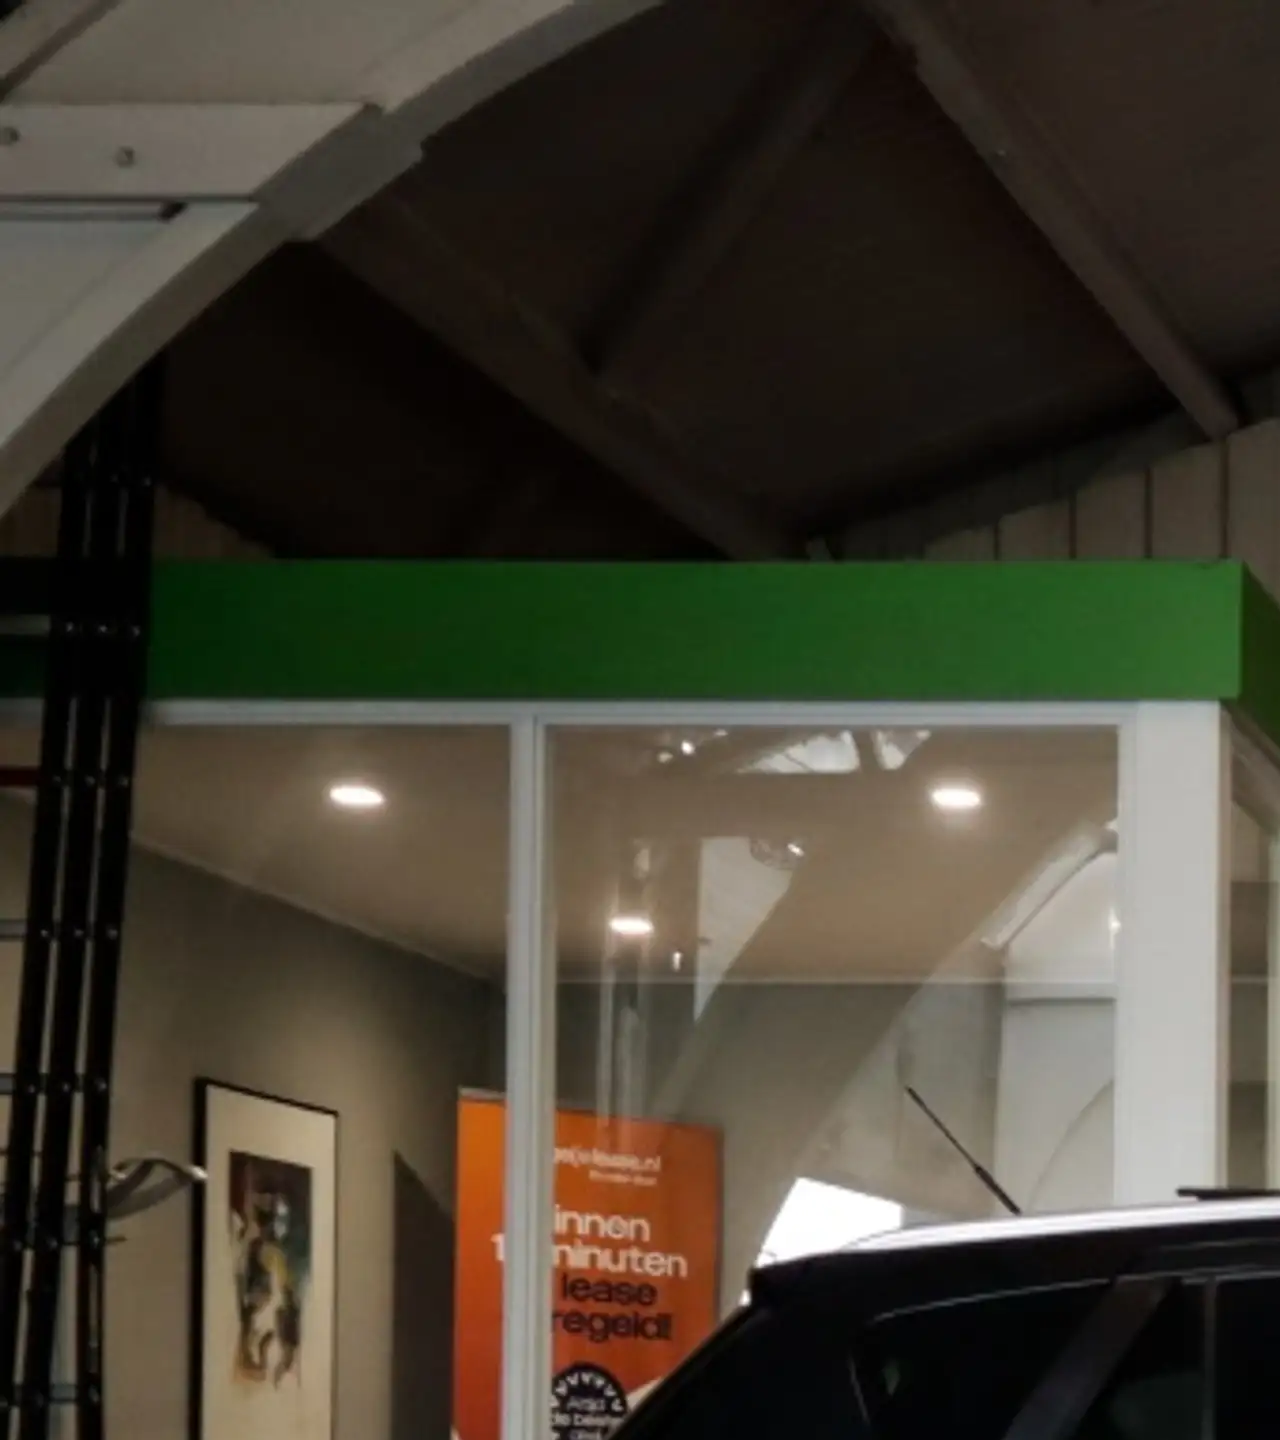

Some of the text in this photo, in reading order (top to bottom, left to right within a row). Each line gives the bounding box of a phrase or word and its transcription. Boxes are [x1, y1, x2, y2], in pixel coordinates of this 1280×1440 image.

[553, 1204, 651, 1243] innen
[561, 1272, 658, 1307] lease
[551, 1308, 673, 1344] regeld!
